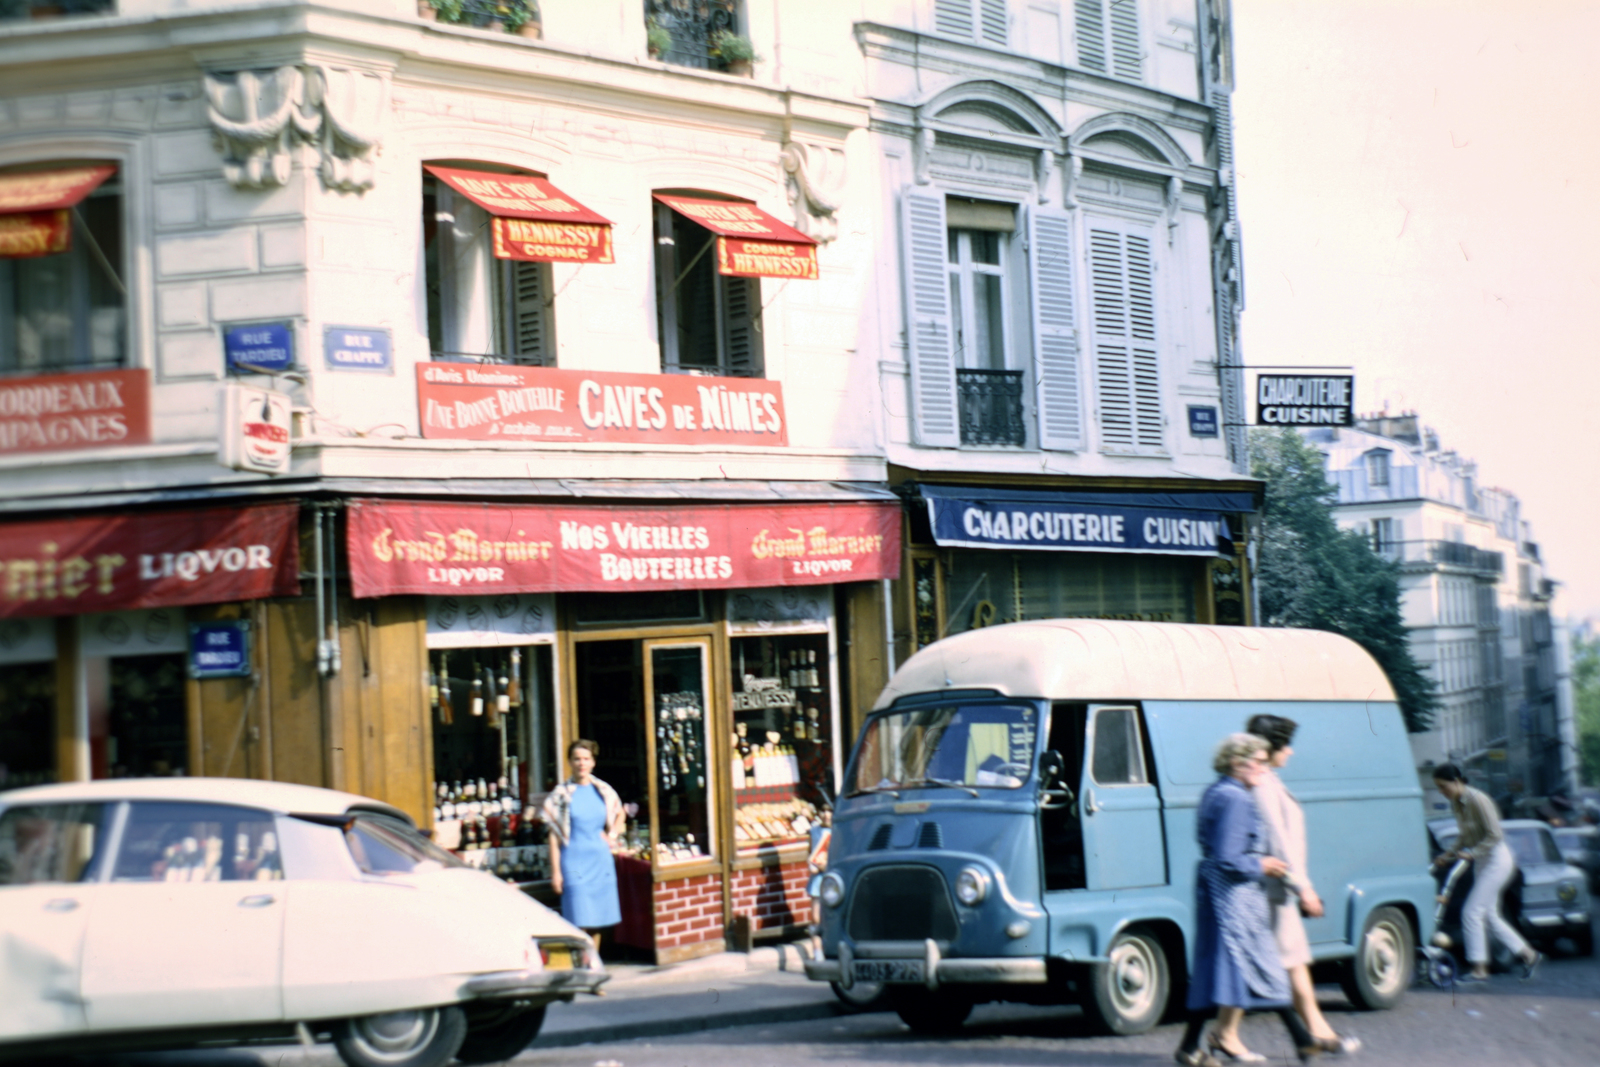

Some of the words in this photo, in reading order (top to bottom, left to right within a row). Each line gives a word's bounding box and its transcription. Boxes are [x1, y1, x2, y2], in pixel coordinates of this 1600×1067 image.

[501, 181, 548, 199] YOU
[507, 219, 602, 247] HENNESSY
[524, 243, 589, 259] COGNAC
[743, 242, 796, 256] COGNAC
[732, 253, 811, 276] HENNESSY
[241, 332, 273, 345] RUE
[343, 335, 374, 348] RUE
[230, 348, 287, 363] TARDIEU
[0, 380, 126, 417] ORDEAUX
[578, 379, 667, 430] CAVES
[672, 404, 697, 430] DE
[1258, 377, 1351, 406] CHARCUTERIE
[454, 396, 501, 429] BONNE
[496, 387, 565, 417] BOUTEILLE
[1262, 406, 1346, 424] CUISINE
[559, 520, 610, 550] NOS
[611, 522, 710, 550] VIEILLES
[963, 507, 1125, 544] CHARCUTERIE
[1142, 516, 1220, 547] CUISIN
[372, 528, 448, 563] Grand
[448, 527, 554, 563] Marnier
[751, 527, 805, 560] Grand
[806, 526, 884, 557] Marnier
[138, 544, 273, 581] LIQVOR
[427, 567, 505, 586] LIQVOR
[599, 553, 733, 582] BOUTEILLES
[792, 558, 853, 576] LIQVOR
